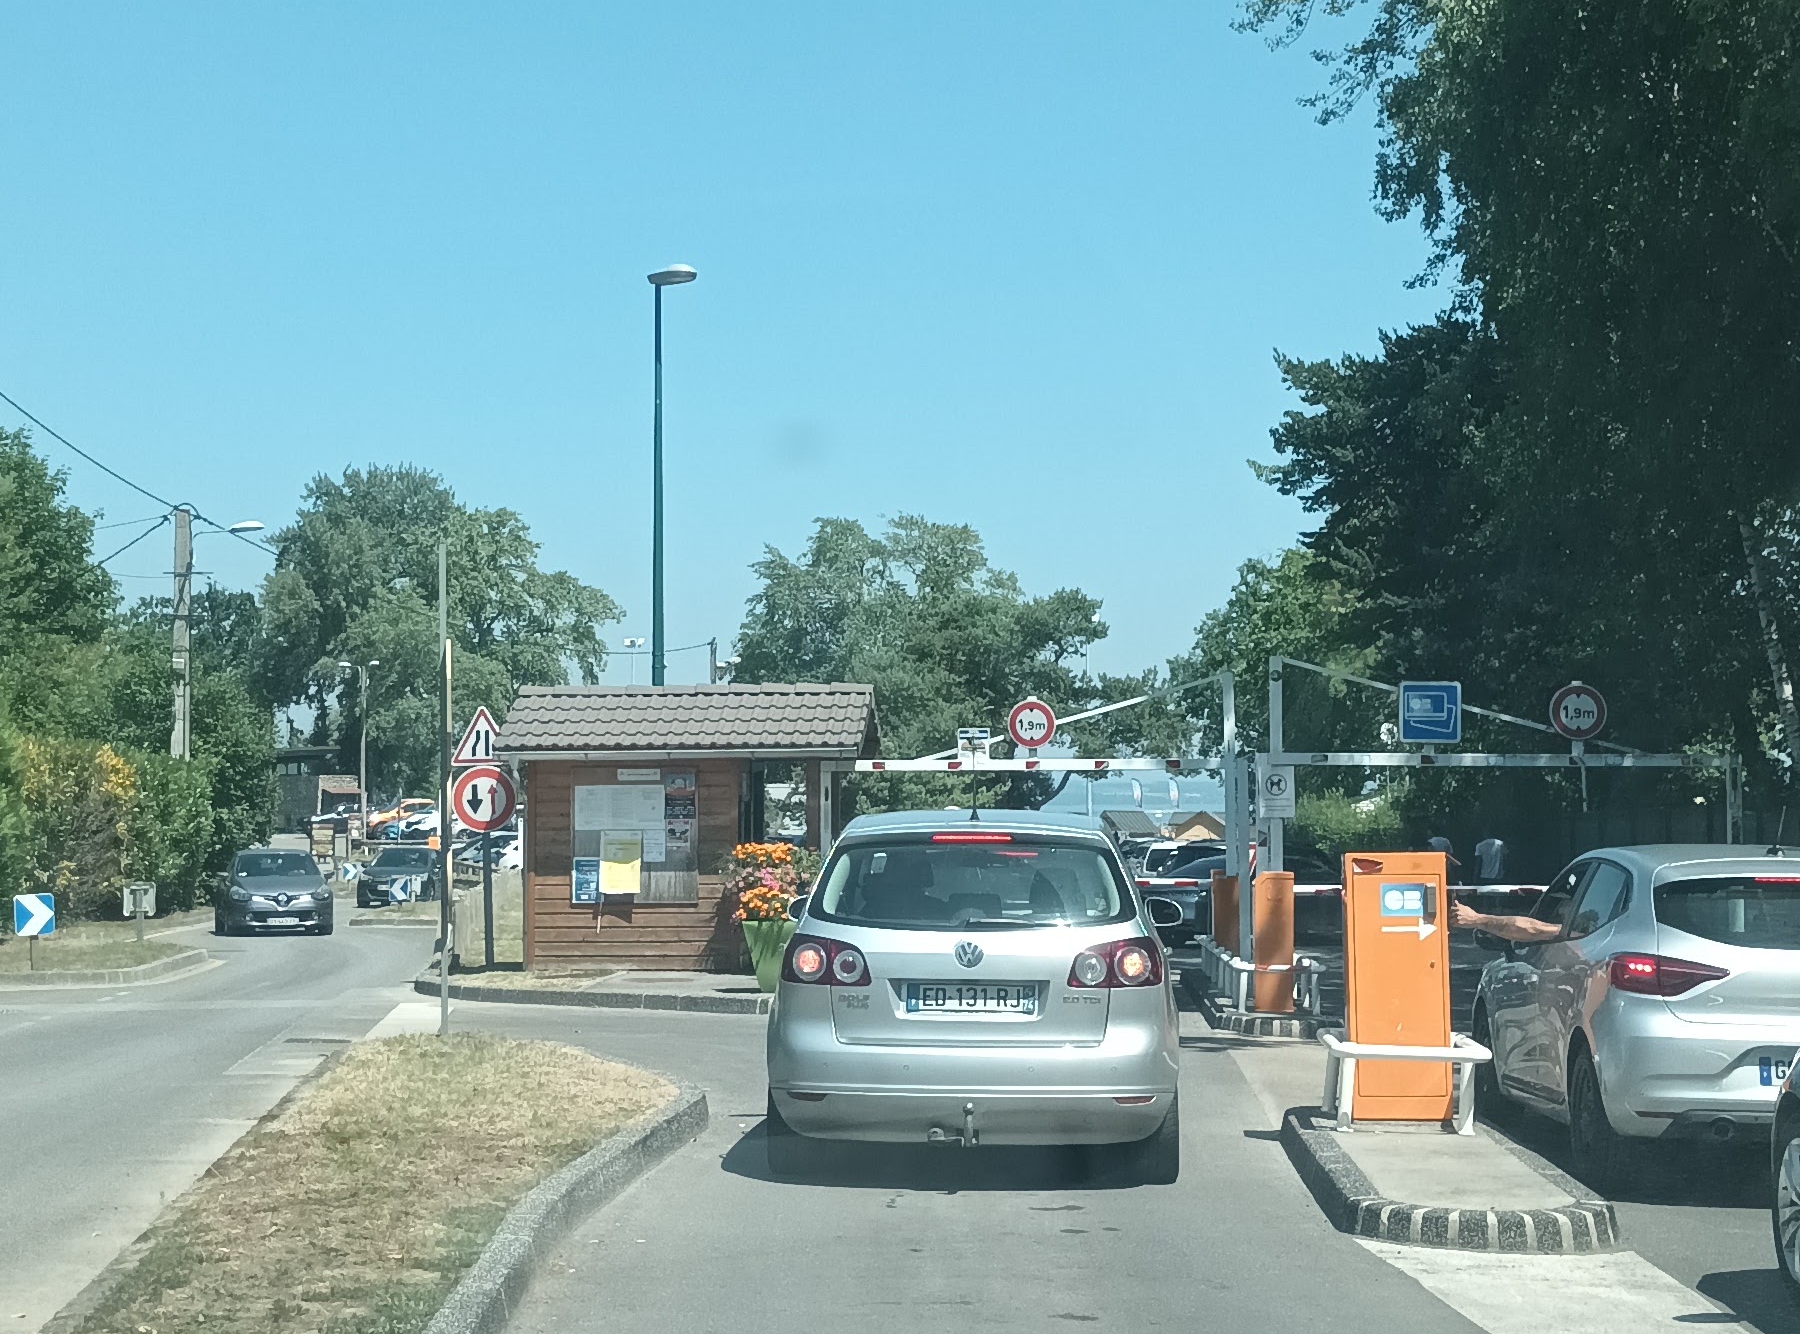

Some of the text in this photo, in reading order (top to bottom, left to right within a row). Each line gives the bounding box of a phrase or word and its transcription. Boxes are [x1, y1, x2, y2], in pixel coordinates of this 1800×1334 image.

[1562, 705, 1595, 721] 1,9m
[1018, 718, 1046, 732] 1,9m
[1384, 889, 1422, 910] CB
